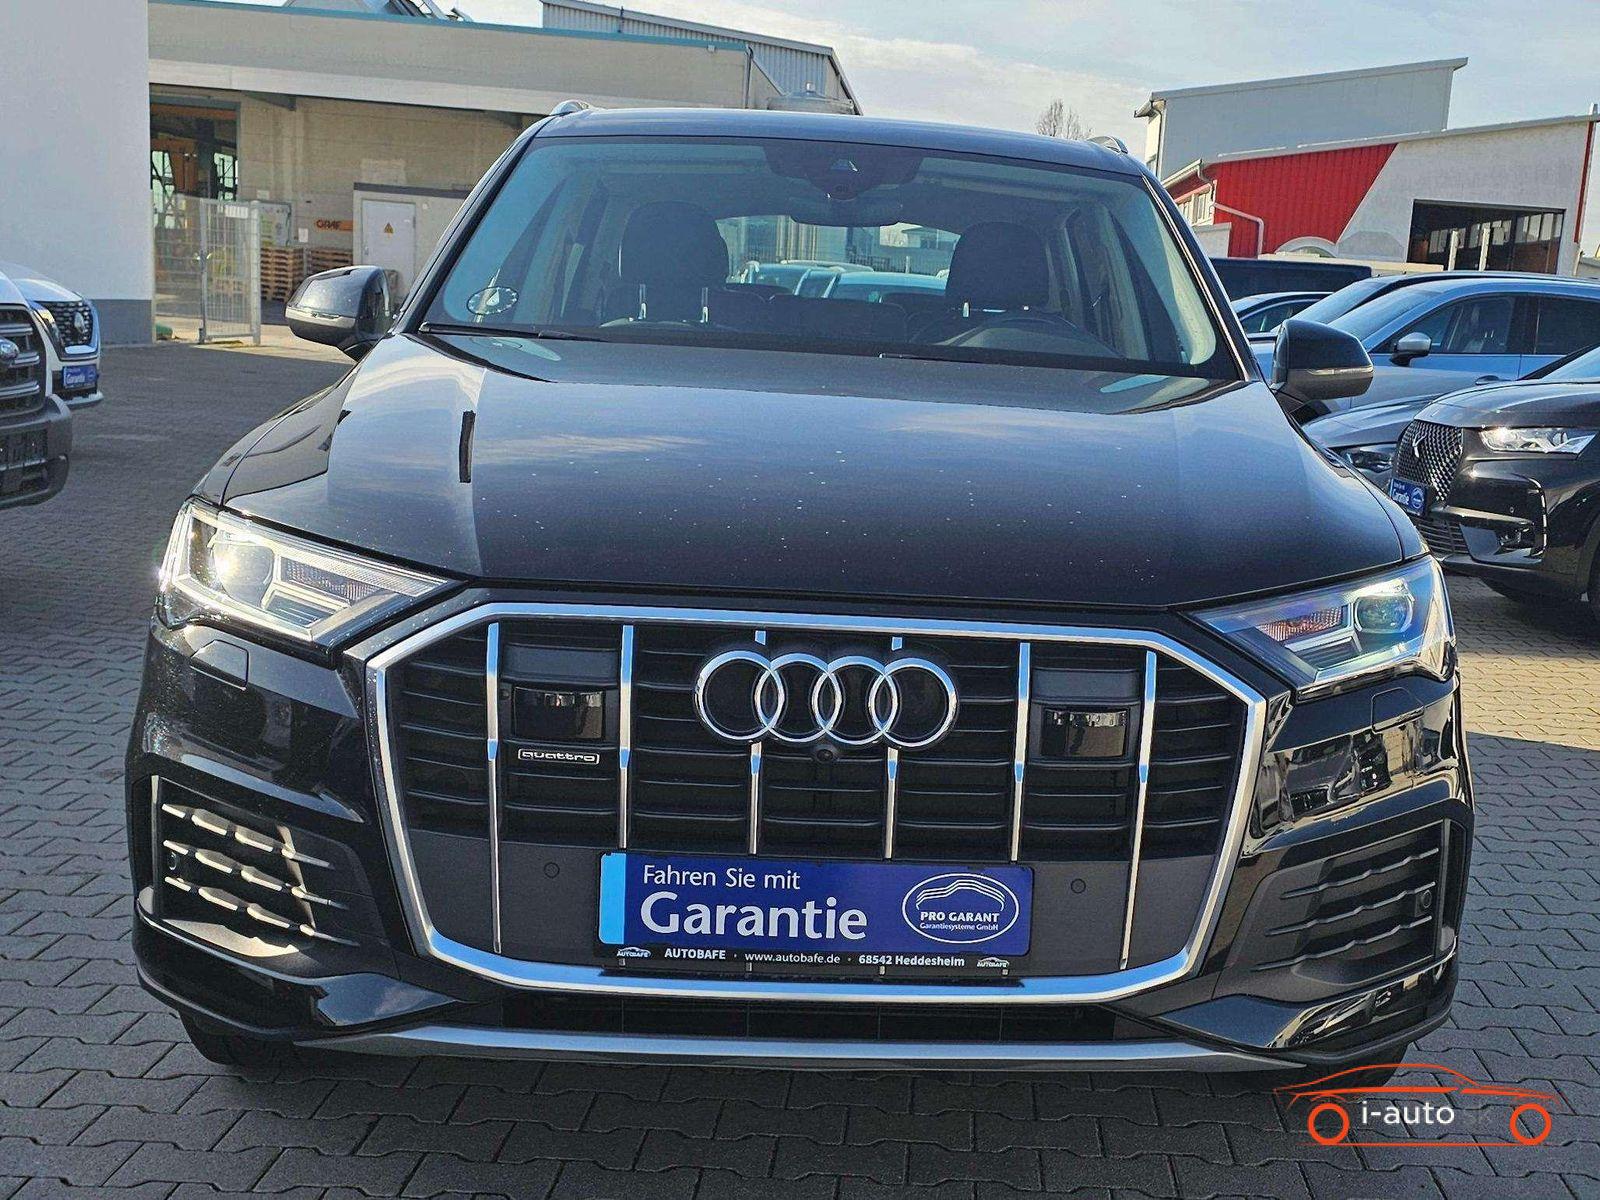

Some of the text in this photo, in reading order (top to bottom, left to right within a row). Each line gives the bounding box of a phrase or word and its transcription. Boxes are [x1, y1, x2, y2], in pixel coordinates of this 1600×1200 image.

[521, 751, 596, 762] quattro
[643, 864, 801, 889] Fahren Sie mit
[640, 891, 868, 940] Garantie
[920, 911, 1000, 923] PRO GARANT
[919, 922, 999, 931] Garantiesysteme GmbH
[664, 948, 965, 967] AUTOBAFE www.autobafe.de 68542 Heddesheim
